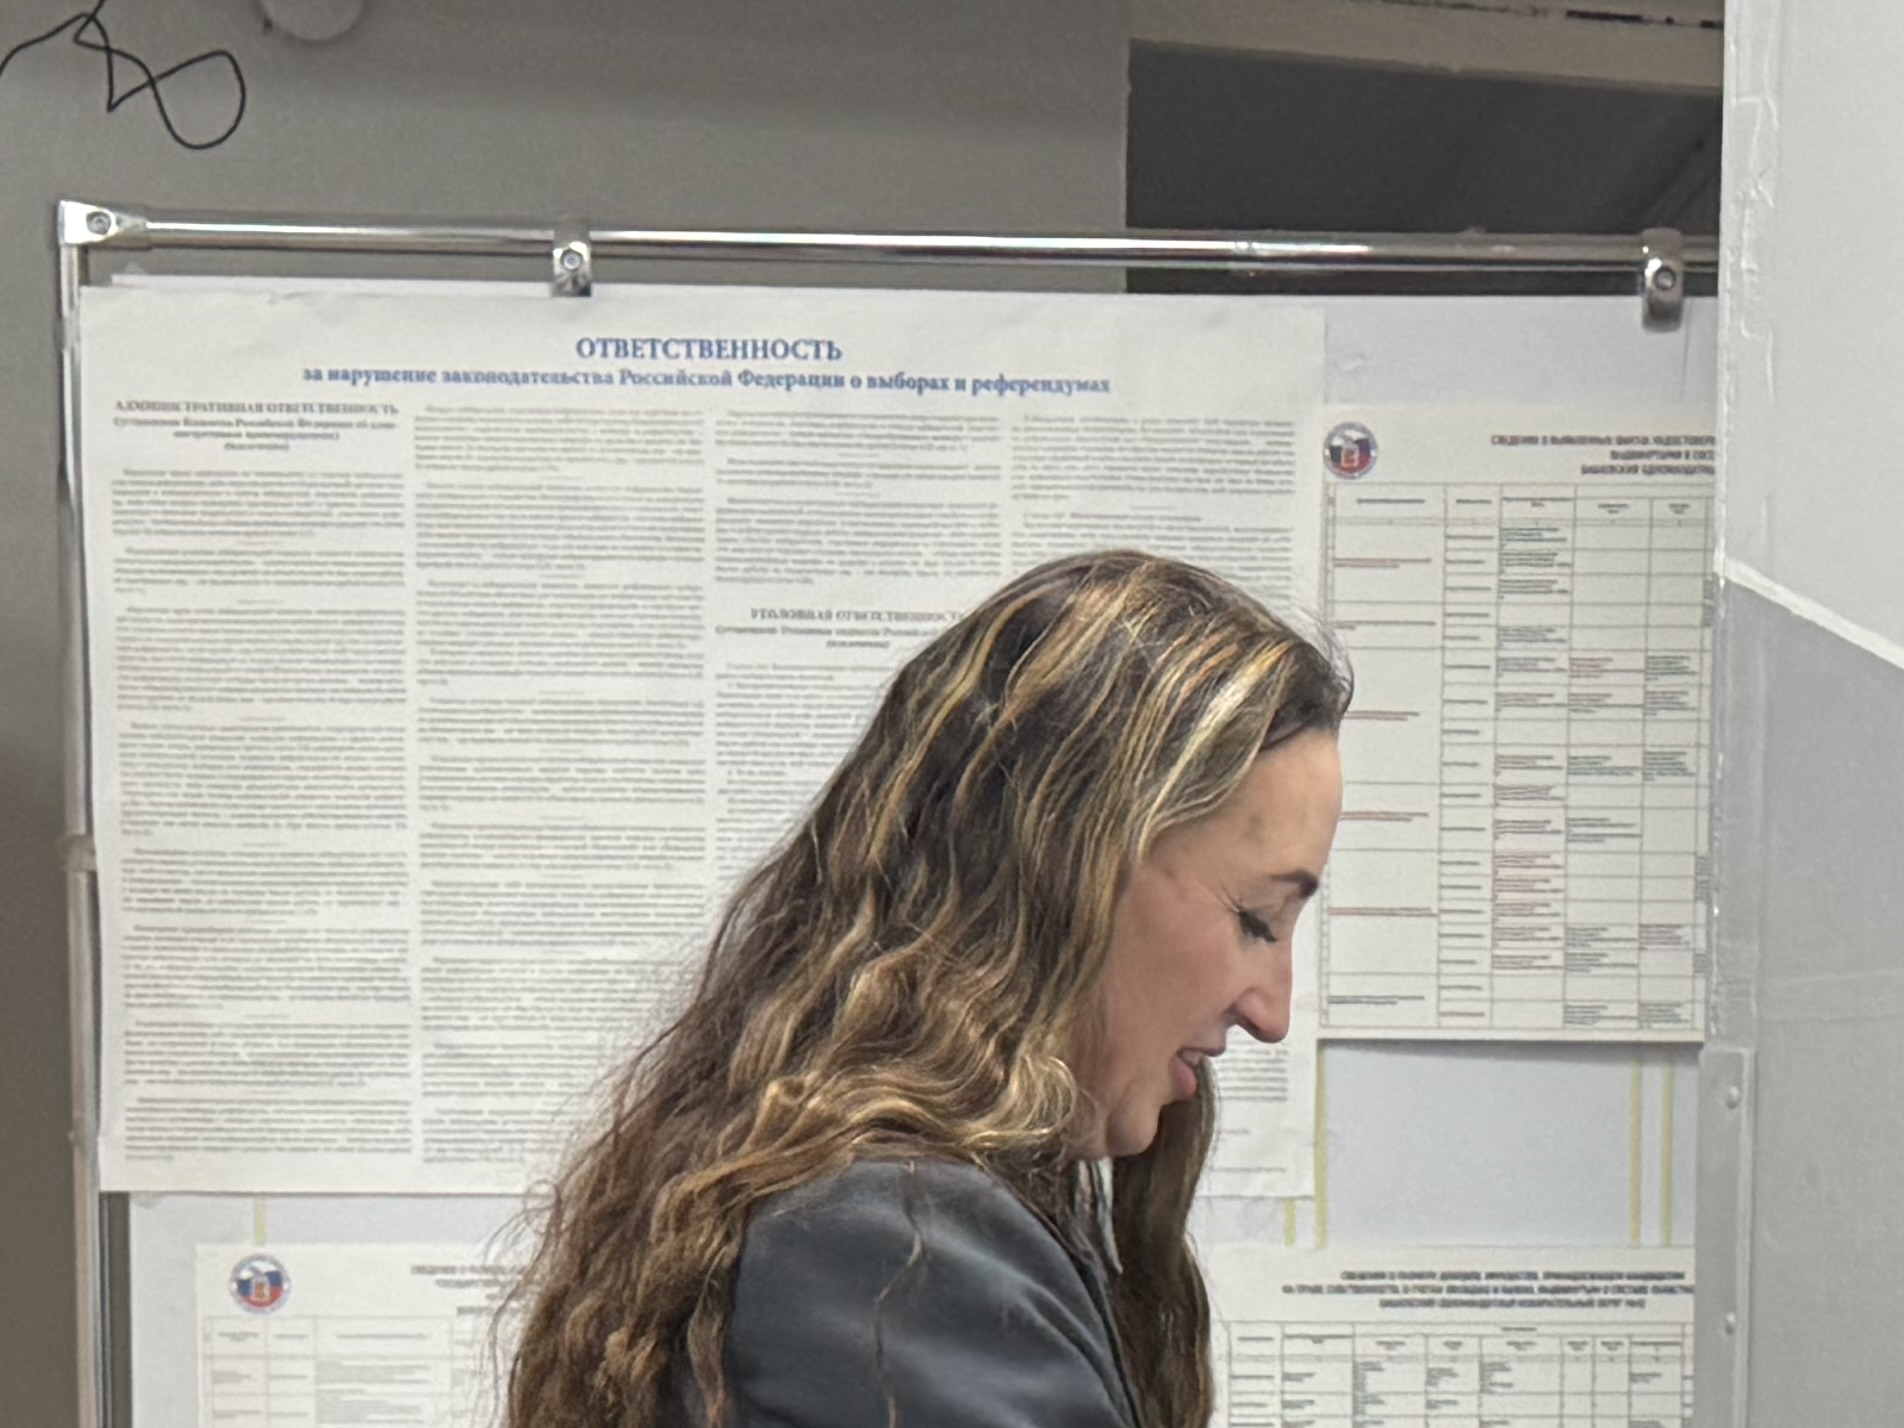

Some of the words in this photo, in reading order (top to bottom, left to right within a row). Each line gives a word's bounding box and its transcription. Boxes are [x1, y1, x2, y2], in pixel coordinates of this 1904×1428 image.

[576, 337, 843, 361] ОТВЕТСТВЕННОСТЬ
[303, 369, 323, 383] за
[328, 368, 436, 394] нарушение
[442, 370, 613, 389] законодательства
[619, 367, 733, 387] Российской
[738, 369, 845, 391] Федерации
[850, 374, 862, 388] о
[867, 370, 950, 395] выборах
[972, 372, 1110, 396] референдумах
